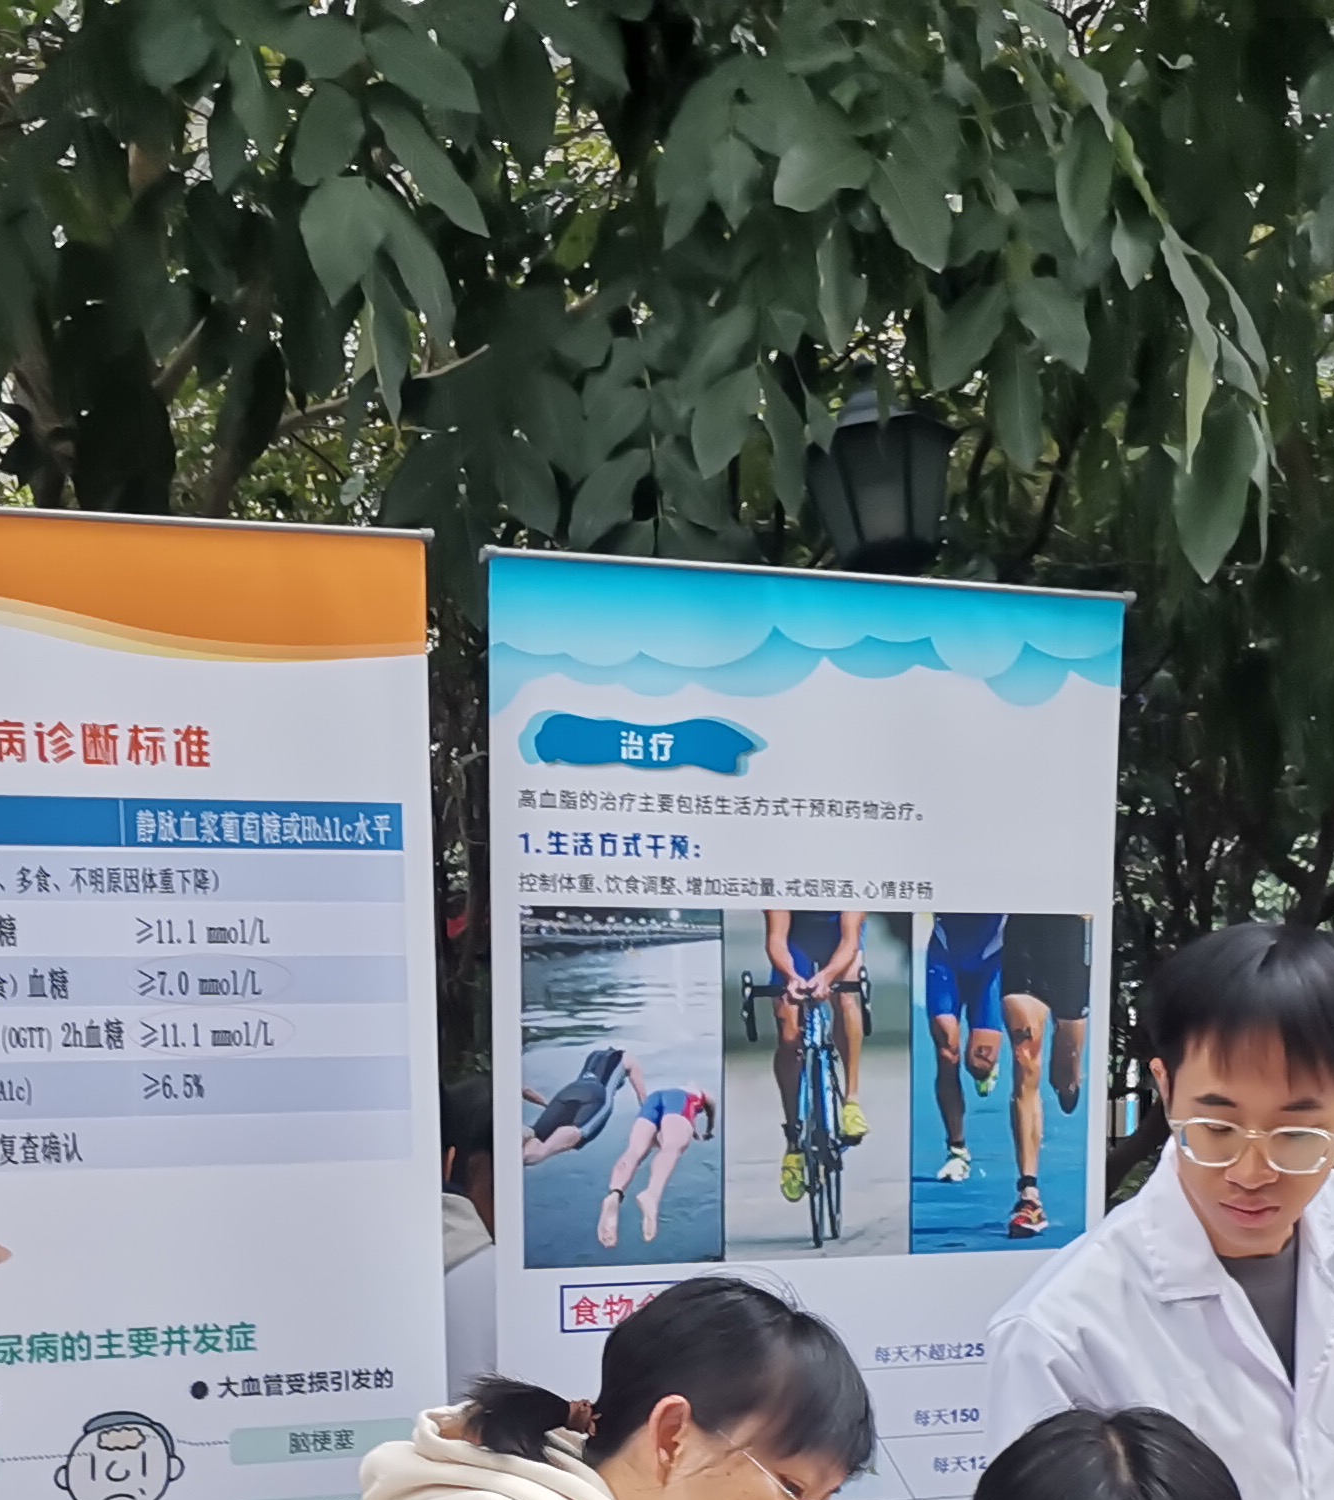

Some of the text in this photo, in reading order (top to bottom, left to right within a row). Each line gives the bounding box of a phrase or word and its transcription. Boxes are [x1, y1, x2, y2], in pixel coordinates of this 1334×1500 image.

[619, 730, 675, 762] 治疗
[206, 916, 270, 946] mmol/L
[198, 969, 263, 999] mmol/L
[210, 1020, 275, 1049] mmol/L
[217, 1367, 394, 1399] 大血管受损引发的
[914, 1408, 980, 1427] 每天150
[288, 1429, 355, 1454] 脑梗塞
